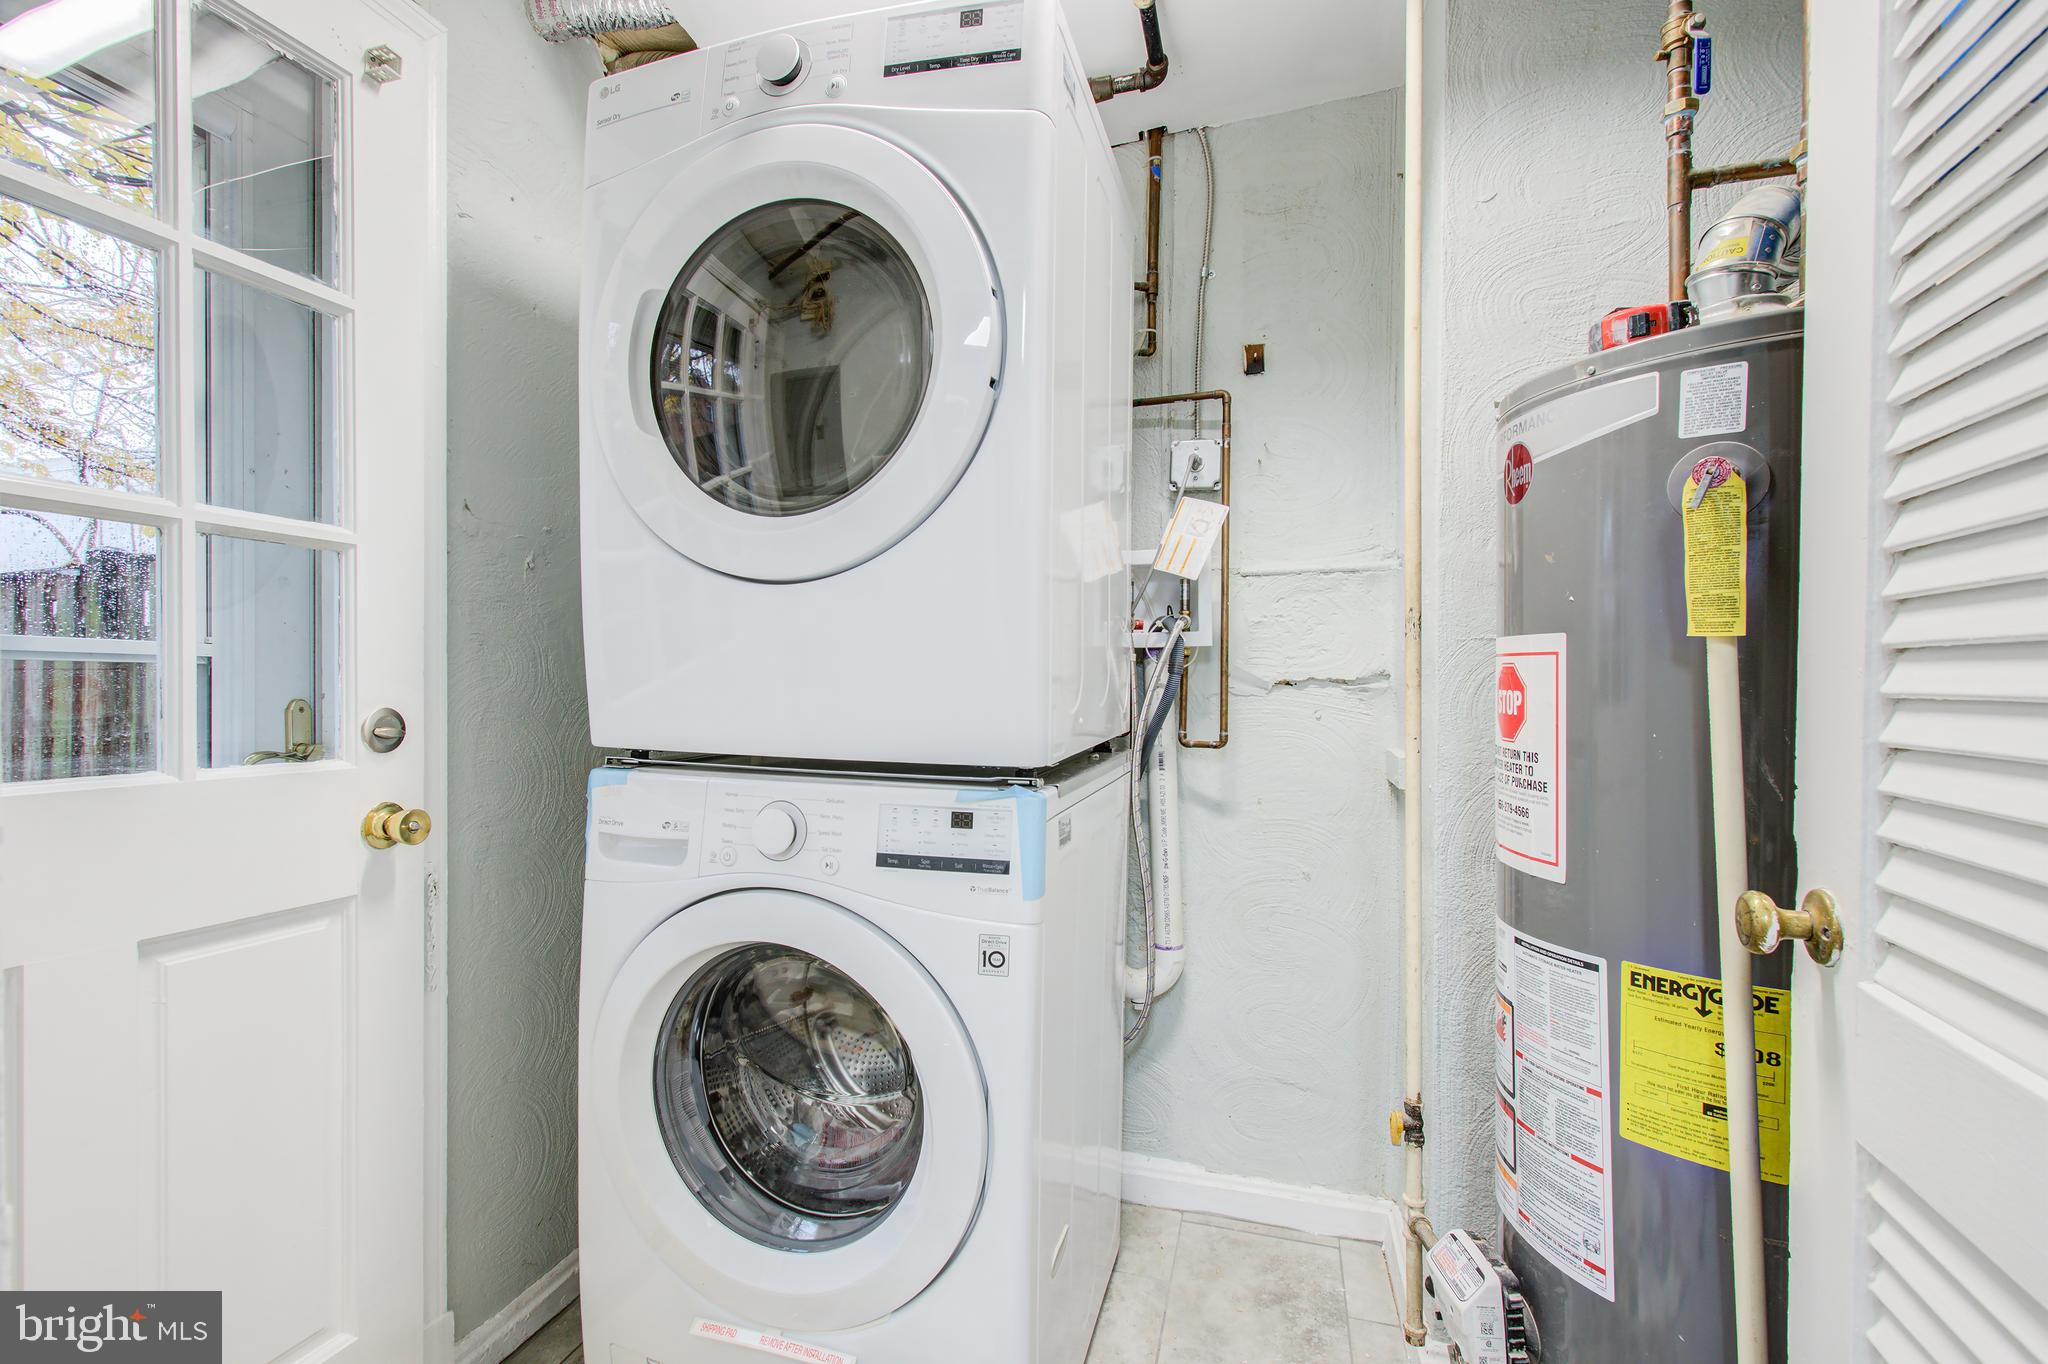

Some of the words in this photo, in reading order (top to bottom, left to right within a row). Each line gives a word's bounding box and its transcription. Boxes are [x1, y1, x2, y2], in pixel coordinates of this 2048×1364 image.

[610, 84, 621, 95] LG
[1506, 448, 1532, 498] Rheem
[1522, 750, 1539, 764] THIS
[1524, 765, 1534, 777] TO
[1511, 776, 1548, 793] PURCHASE
[983, 950, 1006, 969] 10
[1631, 970, 1780, 1018] ENERGYGDE
[1654, 1015, 1682, 1027] Estimated
[1683, 1023, 1703, 1033] Yearly
[1676, 1082, 1690, 1091] First
[1691, 1086, 1706, 1096] Hour
[1707, 1090, 1727, 1101] Rating
[702, 1322, 726, 1336] SHIPPING
[725, 1328, 738, 1338] PAD
[760, 1335, 784, 1350] REMOVE
[783, 1341, 804, 1355] AFTER
[803, 1347, 845, 1364] INSTALLATION
